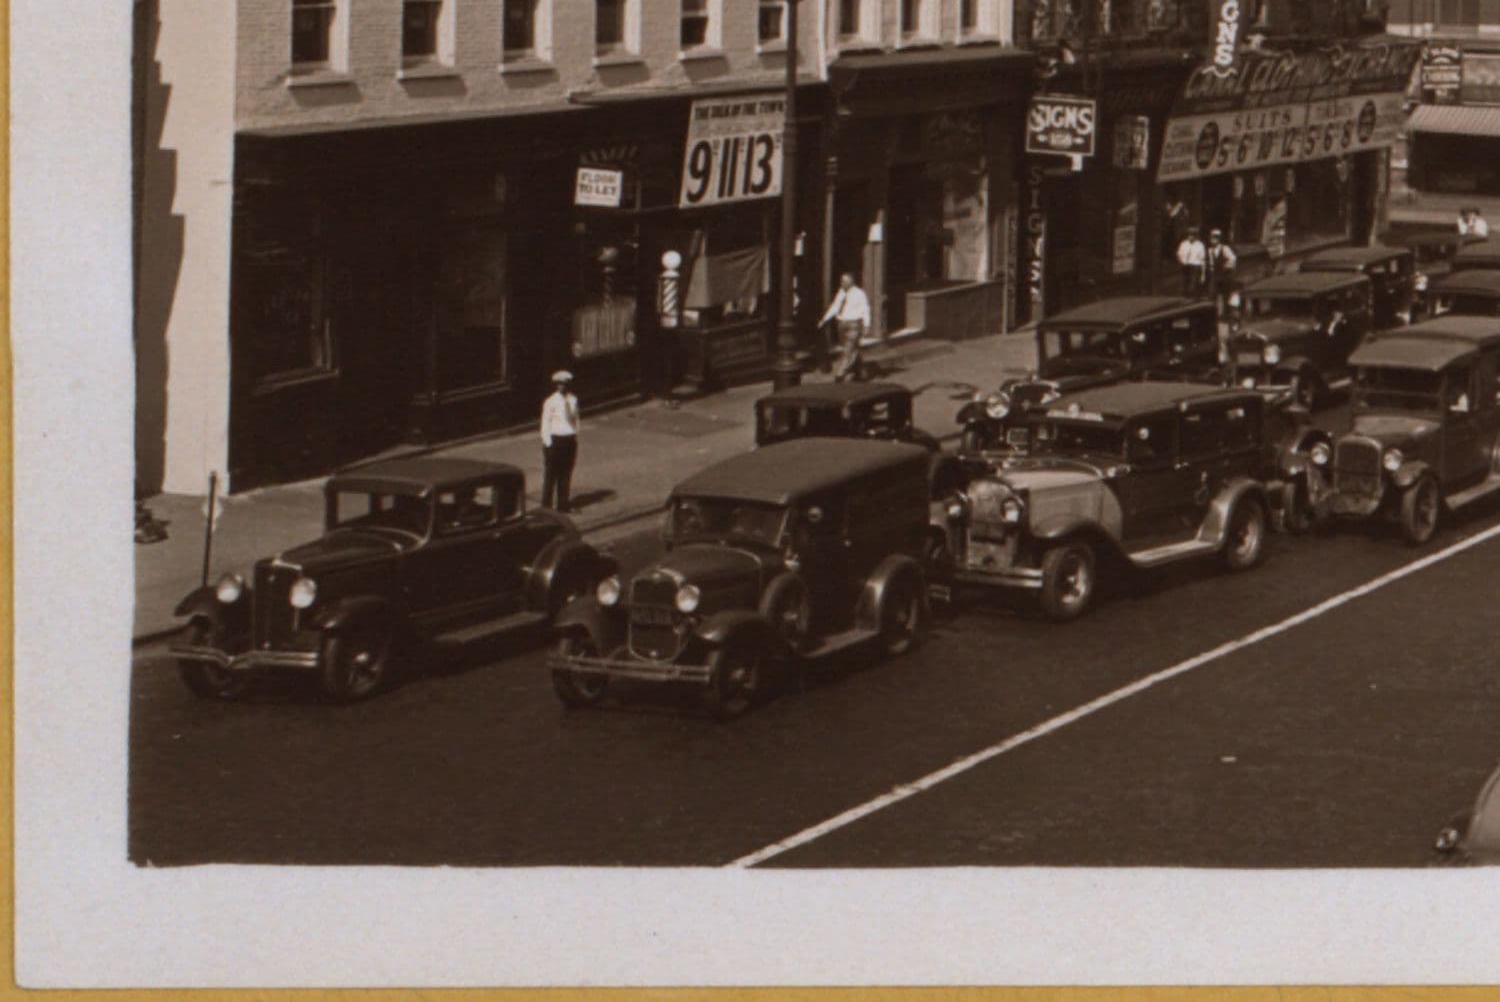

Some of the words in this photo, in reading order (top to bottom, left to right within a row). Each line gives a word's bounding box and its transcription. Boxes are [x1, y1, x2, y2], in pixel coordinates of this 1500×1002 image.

[1029, 103, 1093, 136] SIGNS
[1232, 110, 1292, 133] SUITS
[596, 184, 616, 197] LET
